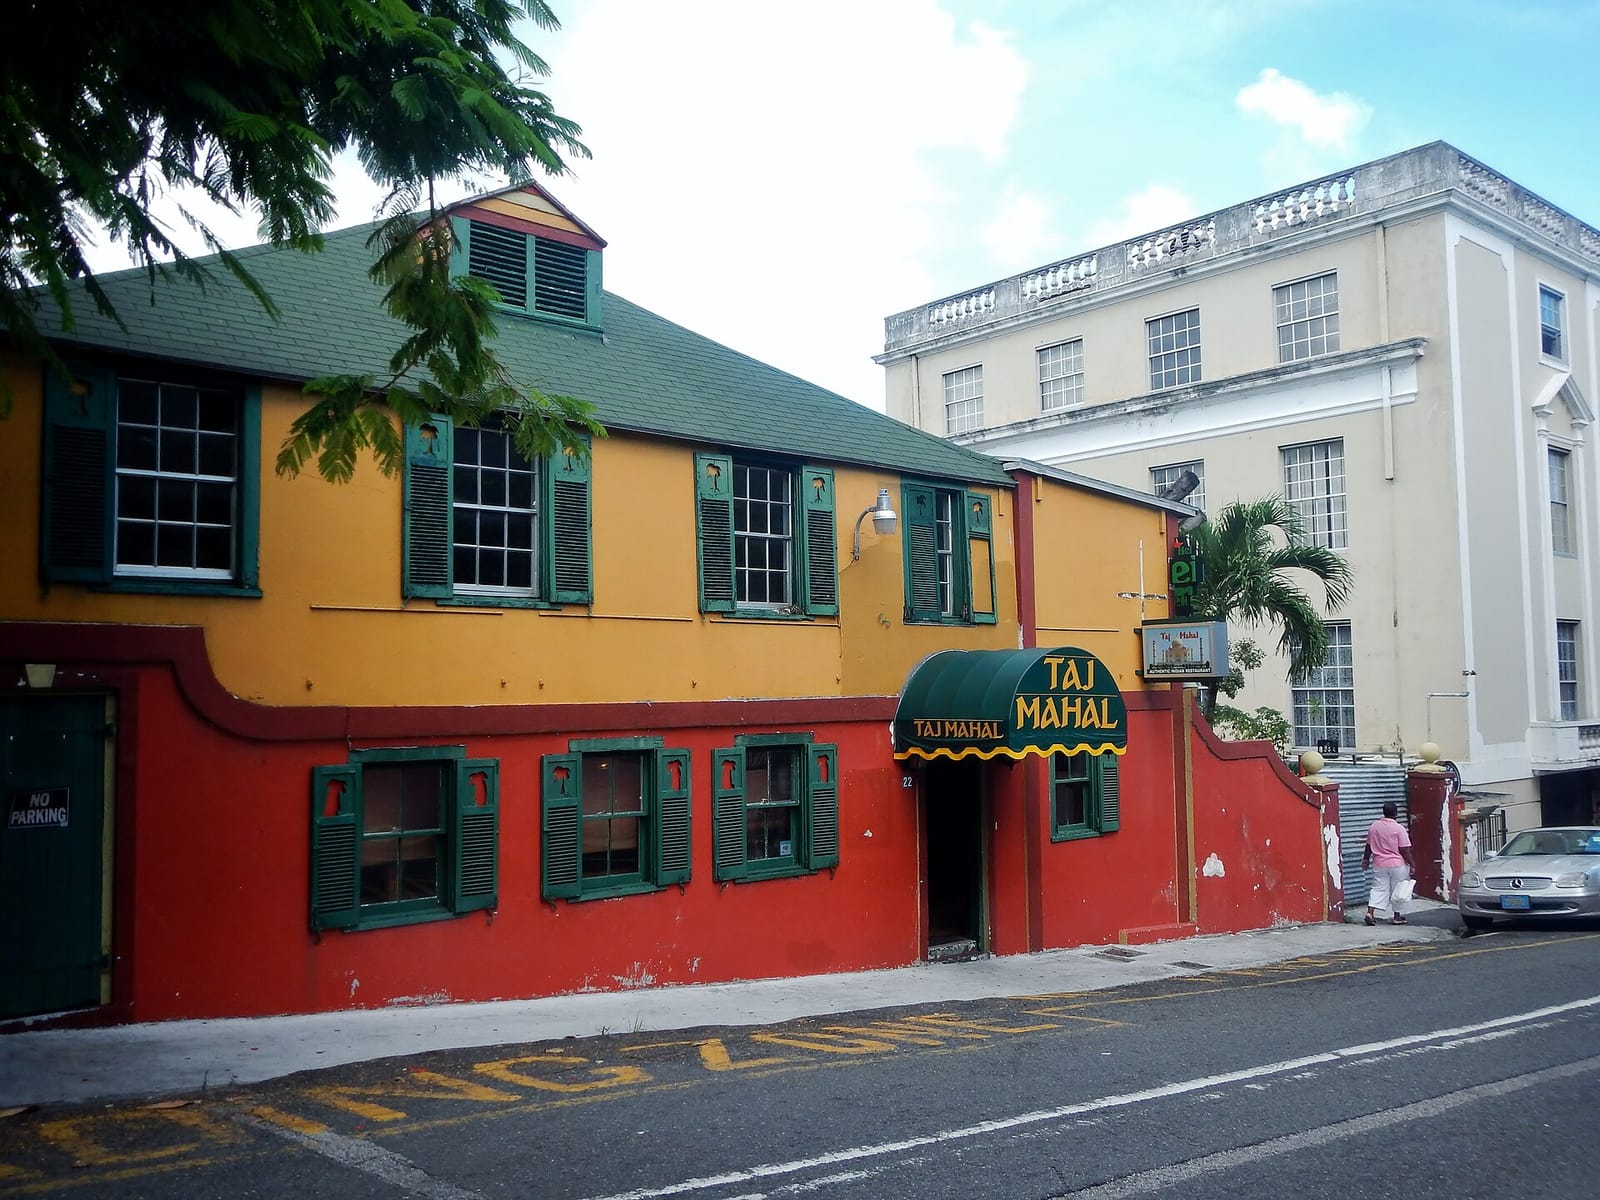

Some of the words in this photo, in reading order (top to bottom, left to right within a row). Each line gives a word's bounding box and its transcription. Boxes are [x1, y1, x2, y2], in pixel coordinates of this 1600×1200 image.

[1160, 632, 1170, 642] Taj
[1179, 631, 1199, 640] Mahal
[1043, 657, 1095, 691] TAJ
[1015, 696, 1119, 730] MAHAL
[913, 720, 941, 737] TAJ
[944, 721, 1004, 739] MAHAL
[902, 776, 913, 788] 22
[30, 792, 50, 807] NO
[11, 807, 67, 825] PARKING
